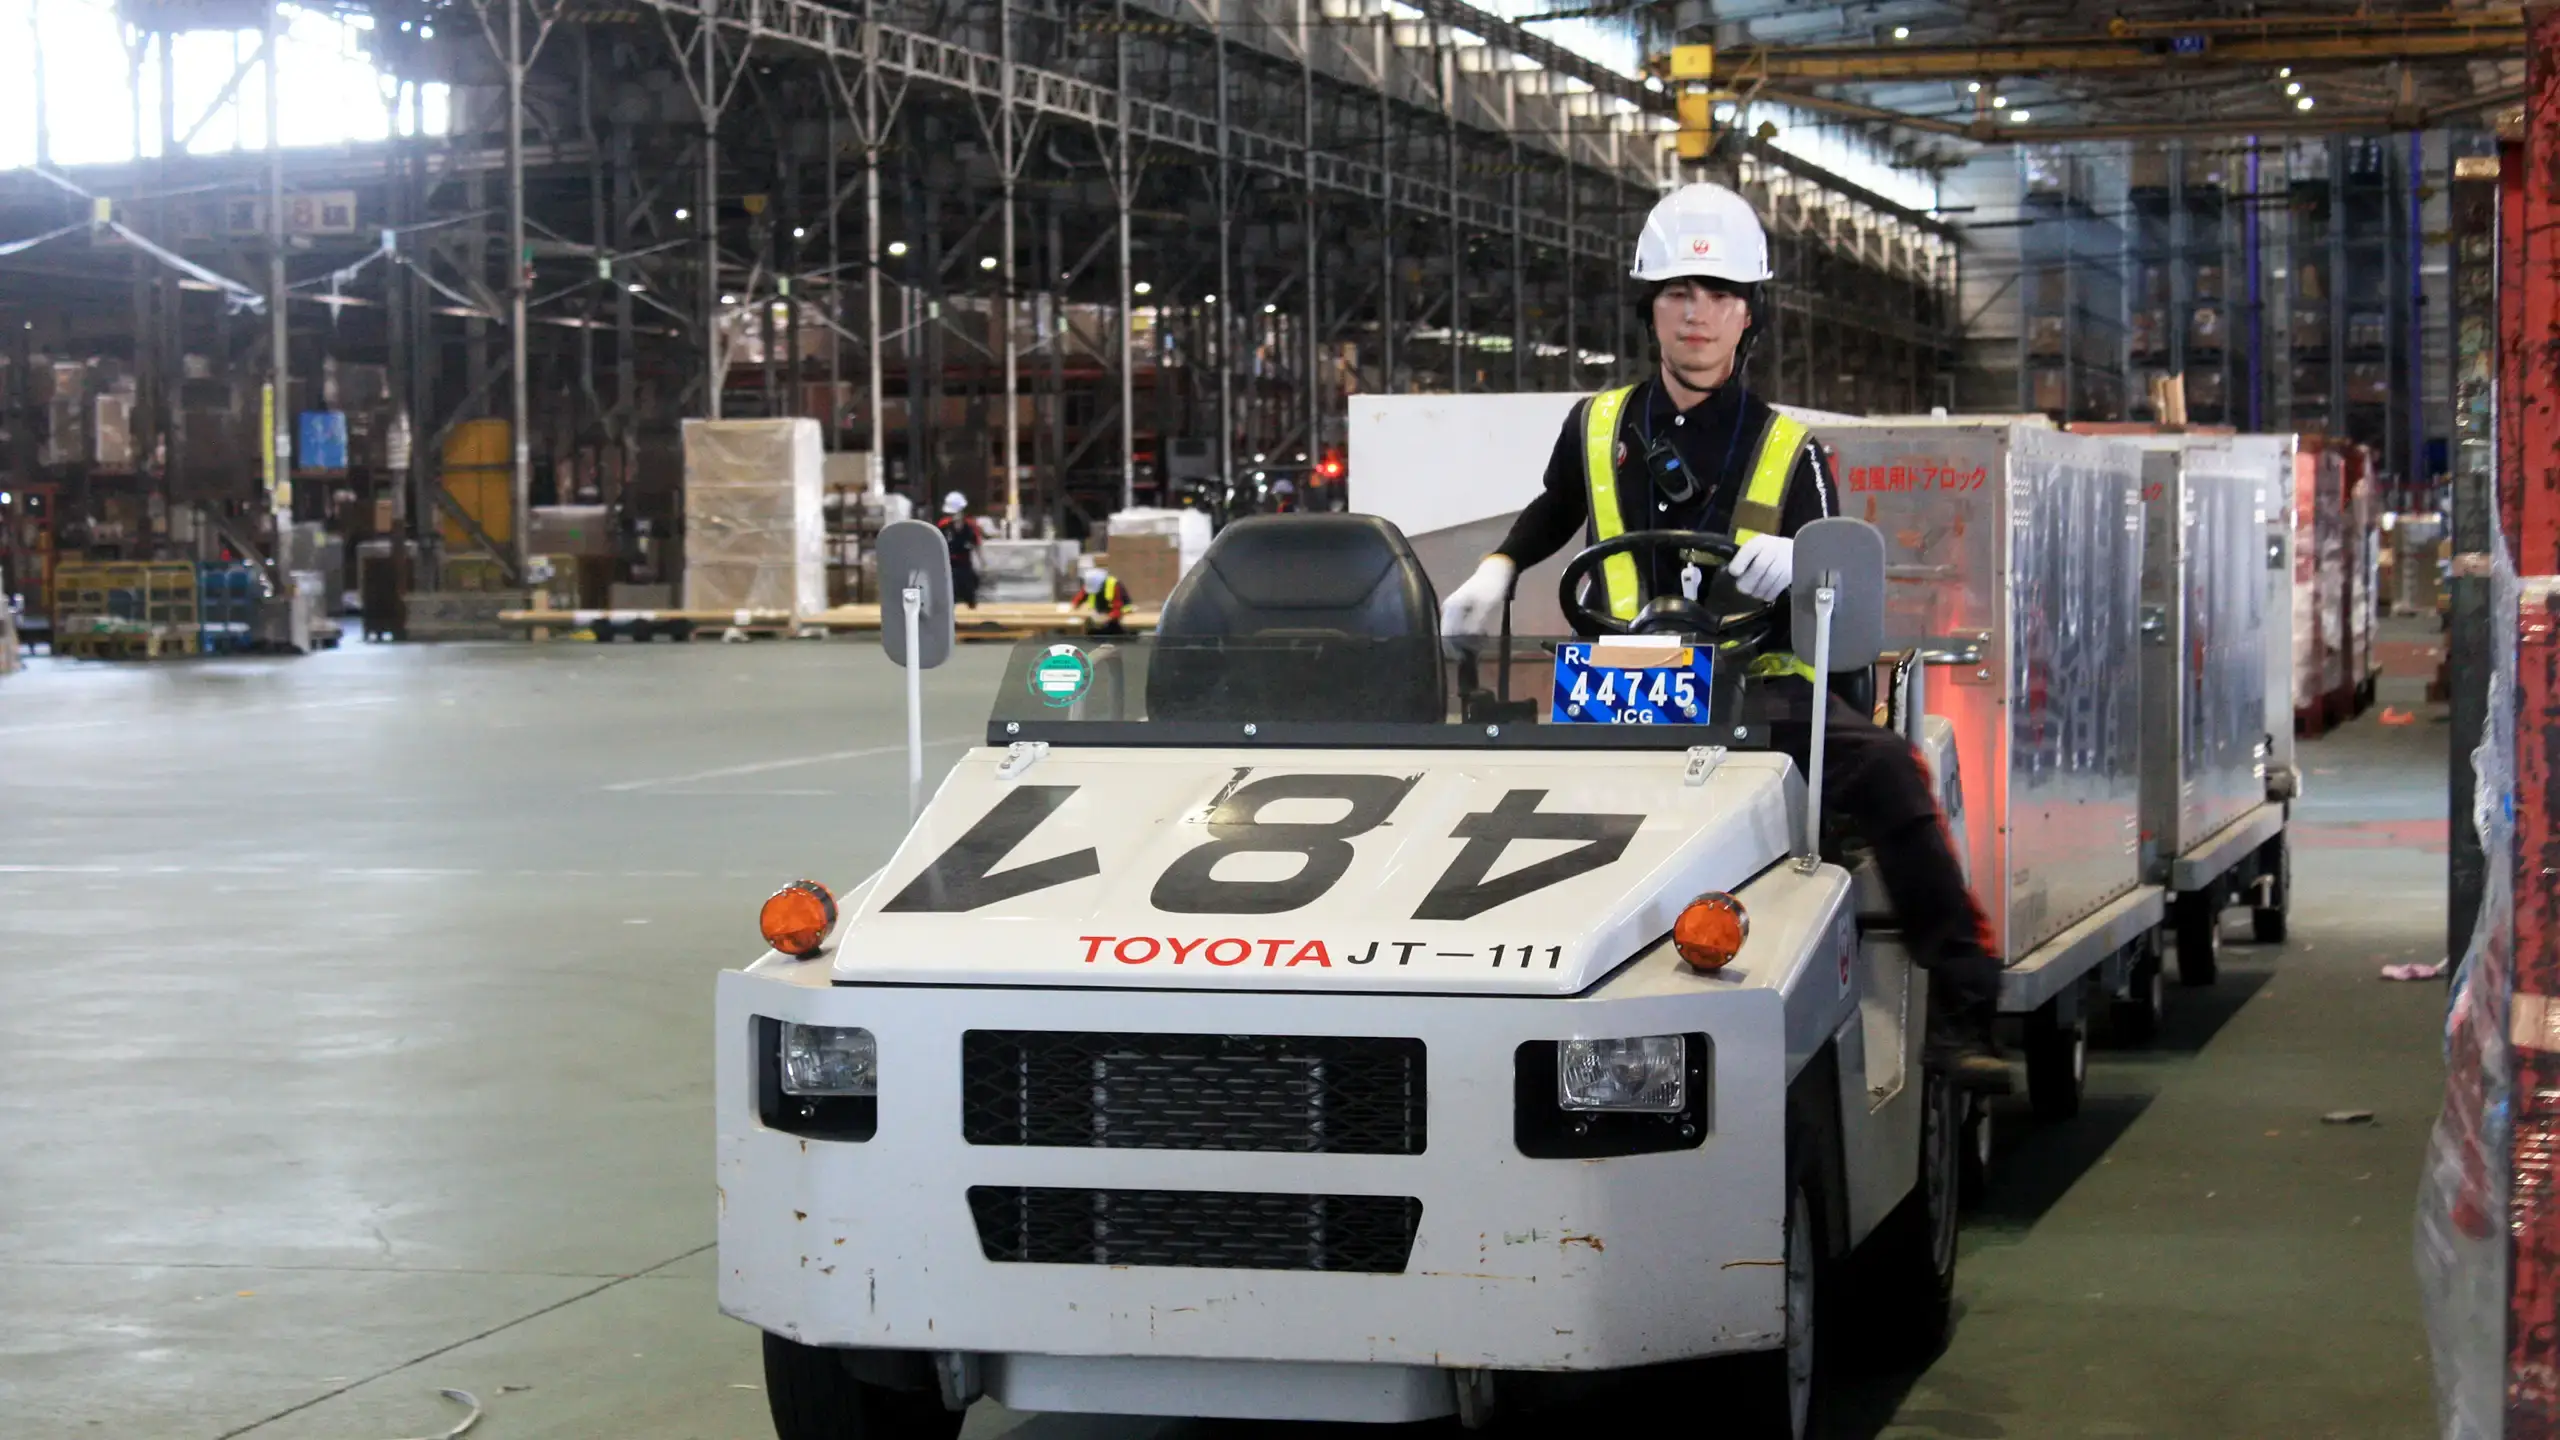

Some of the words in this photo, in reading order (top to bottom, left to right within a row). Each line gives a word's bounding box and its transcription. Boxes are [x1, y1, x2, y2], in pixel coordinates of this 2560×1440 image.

[1848, 466, 1987, 492] 強風用ドアロック
[1569, 671, 1697, 708] 44745
[1611, 708, 1654, 723] JCG
[1080, 936, 1333, 967] TOYOTA
